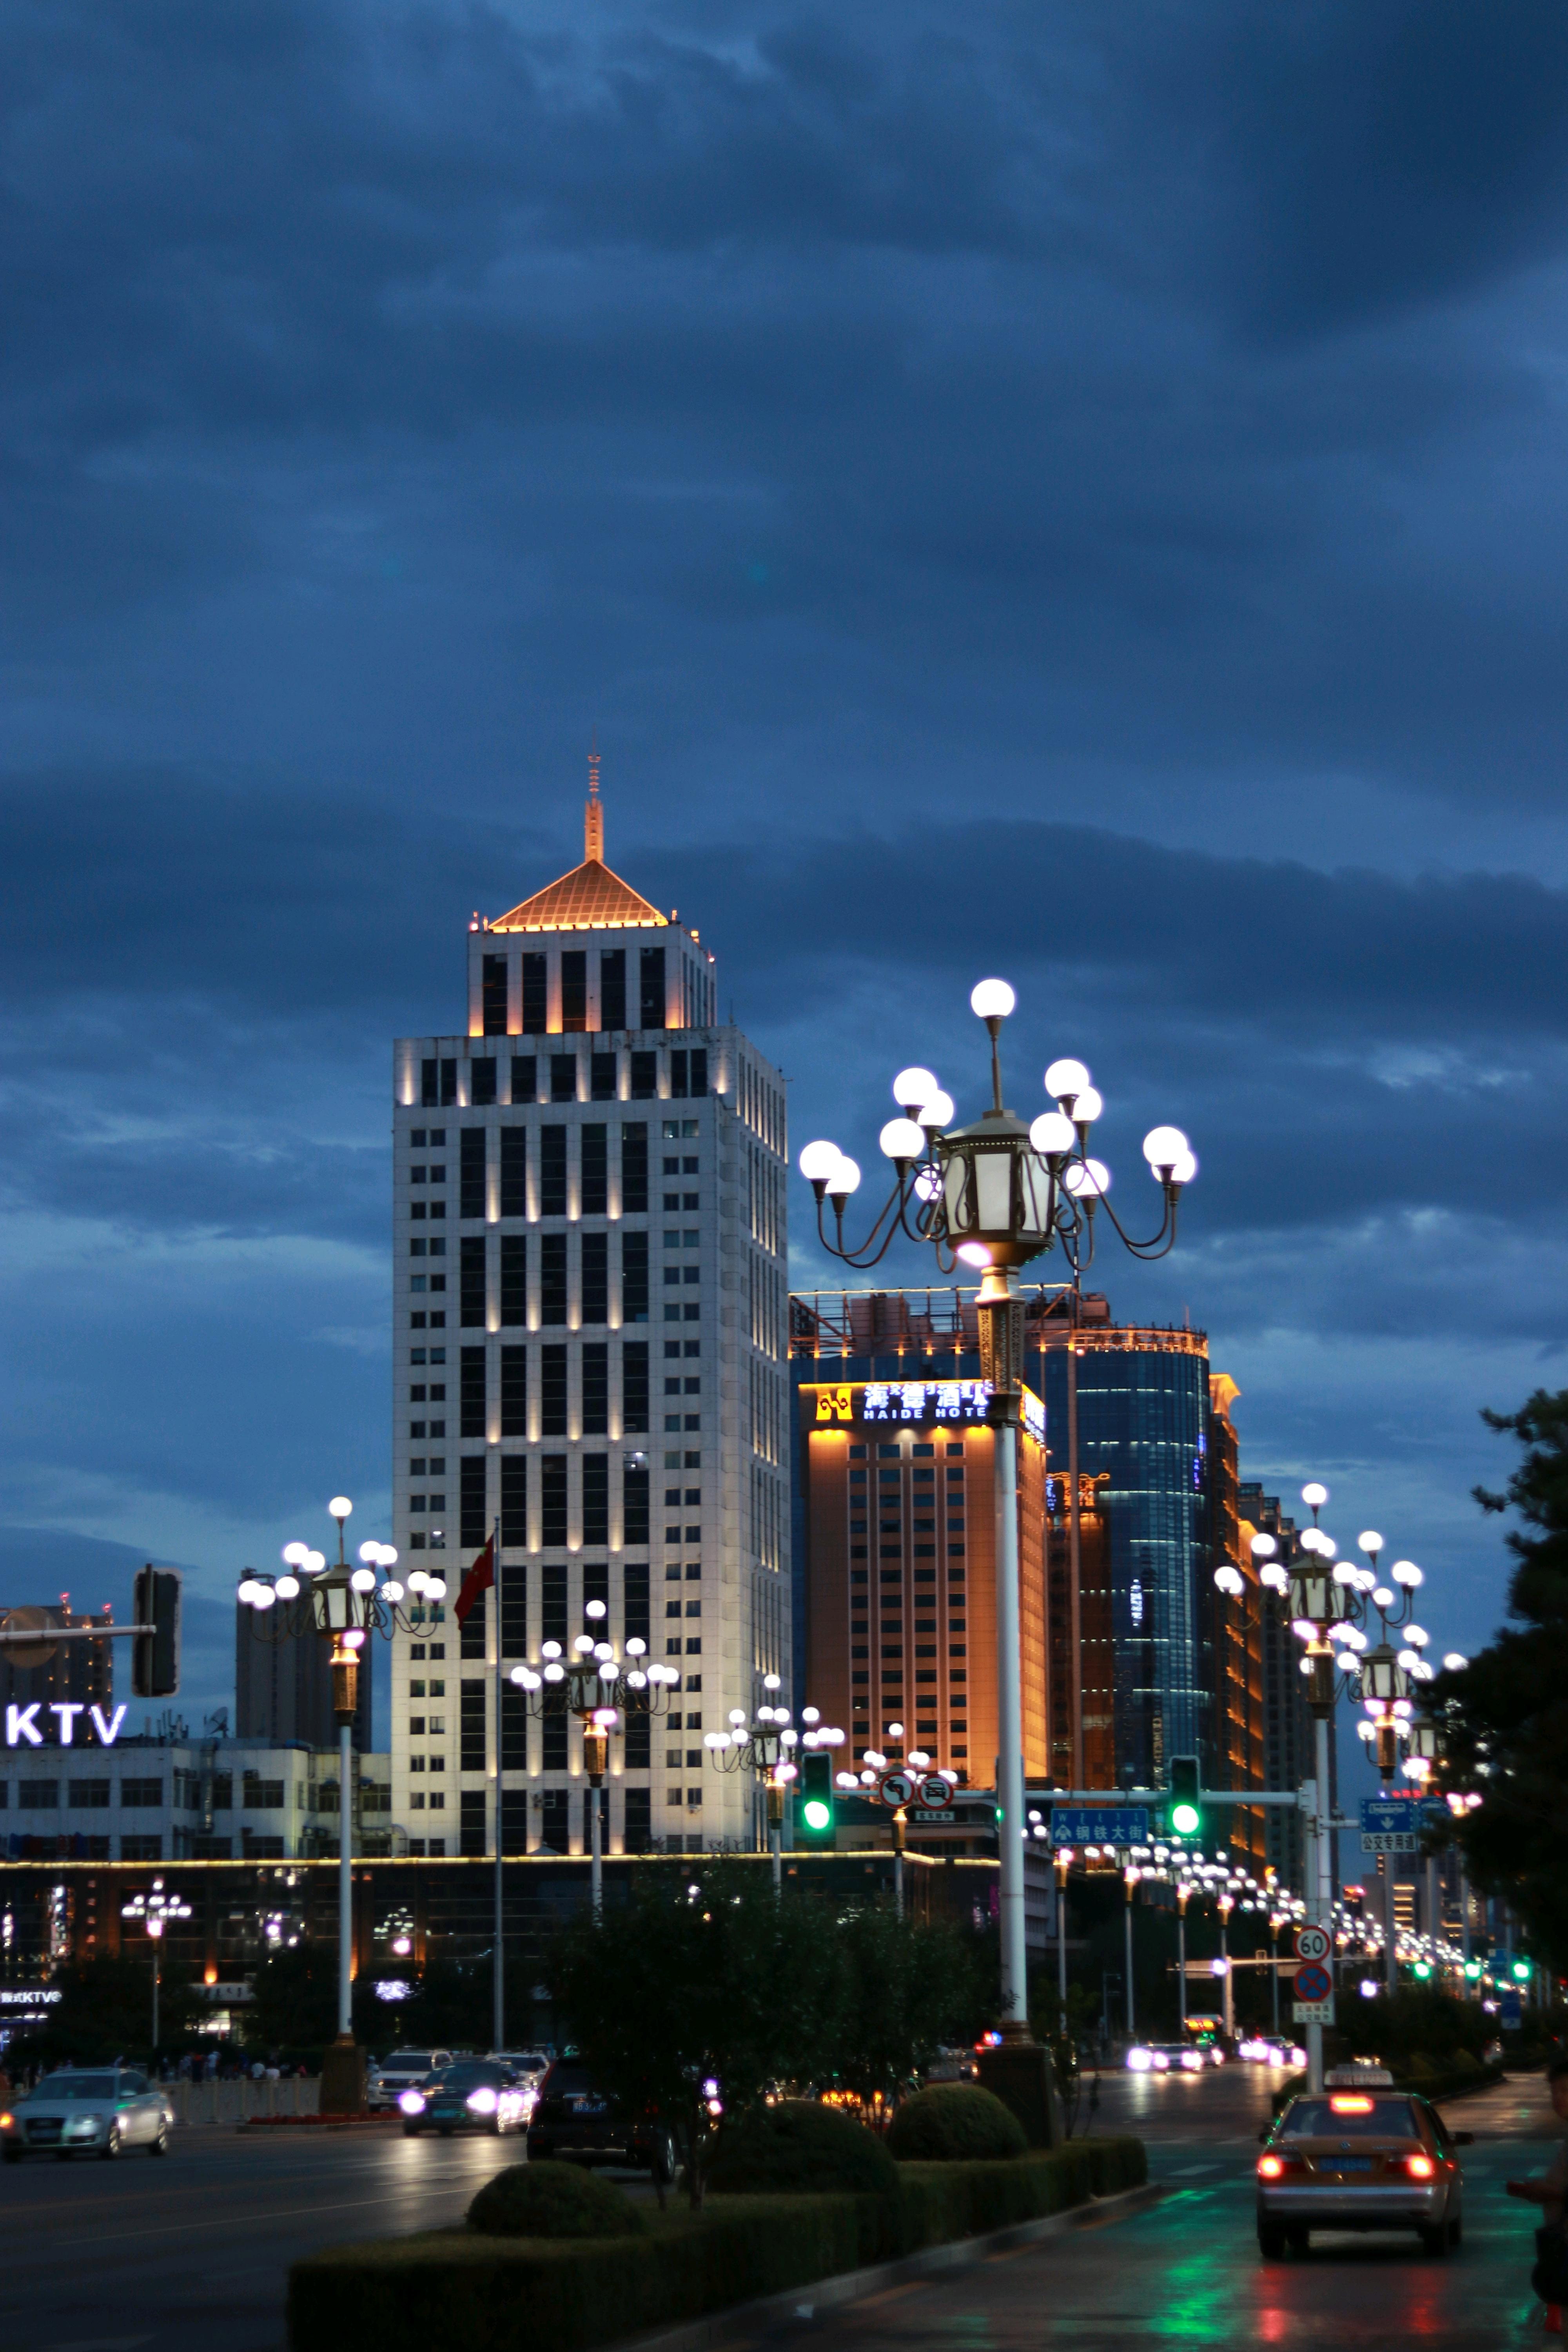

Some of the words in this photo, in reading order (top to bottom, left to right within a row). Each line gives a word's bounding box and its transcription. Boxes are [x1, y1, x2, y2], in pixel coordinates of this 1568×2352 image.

[864, 1409, 923, 1419] HAIDE
[935, 1407, 986, 1418] HOTE
[6, 1704, 127, 1744] KTV
[1059, 1813, 1067, 1822] W
[1076, 1825, 1142, 1840] 钢铁大街
[1363, 1834, 1415, 1849] 公交专用道
[1301, 1935, 1323, 1954] 60
